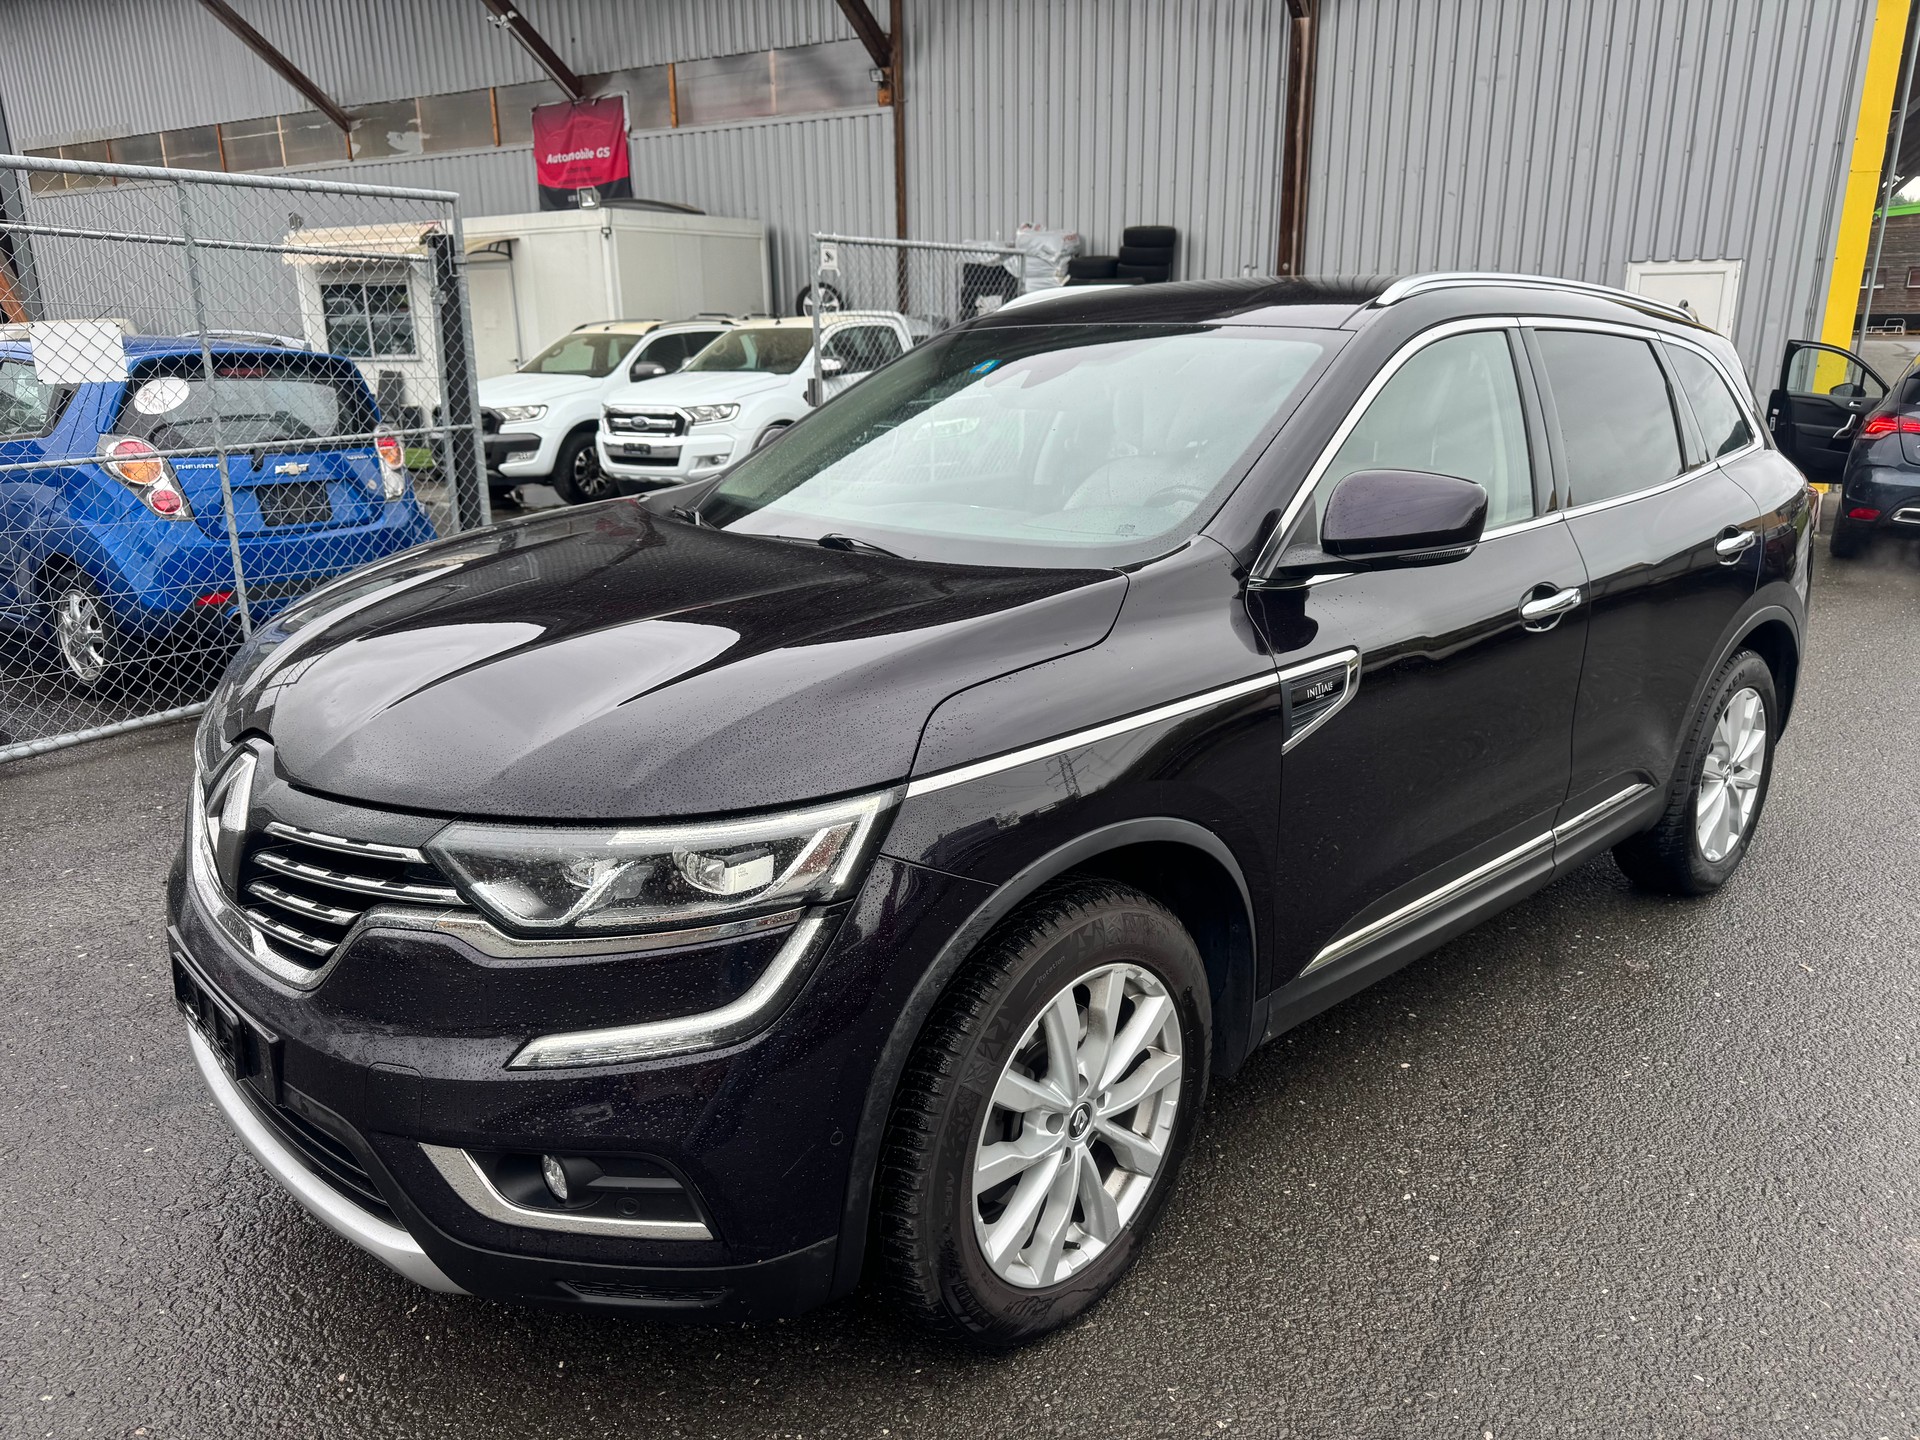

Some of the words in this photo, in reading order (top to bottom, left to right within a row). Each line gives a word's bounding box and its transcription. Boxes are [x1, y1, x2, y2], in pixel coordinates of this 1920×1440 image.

[546, 147, 594, 164] Automobile
[596, 146, 610, 158] GS
[1713, 669, 1745, 721] NEXEN
